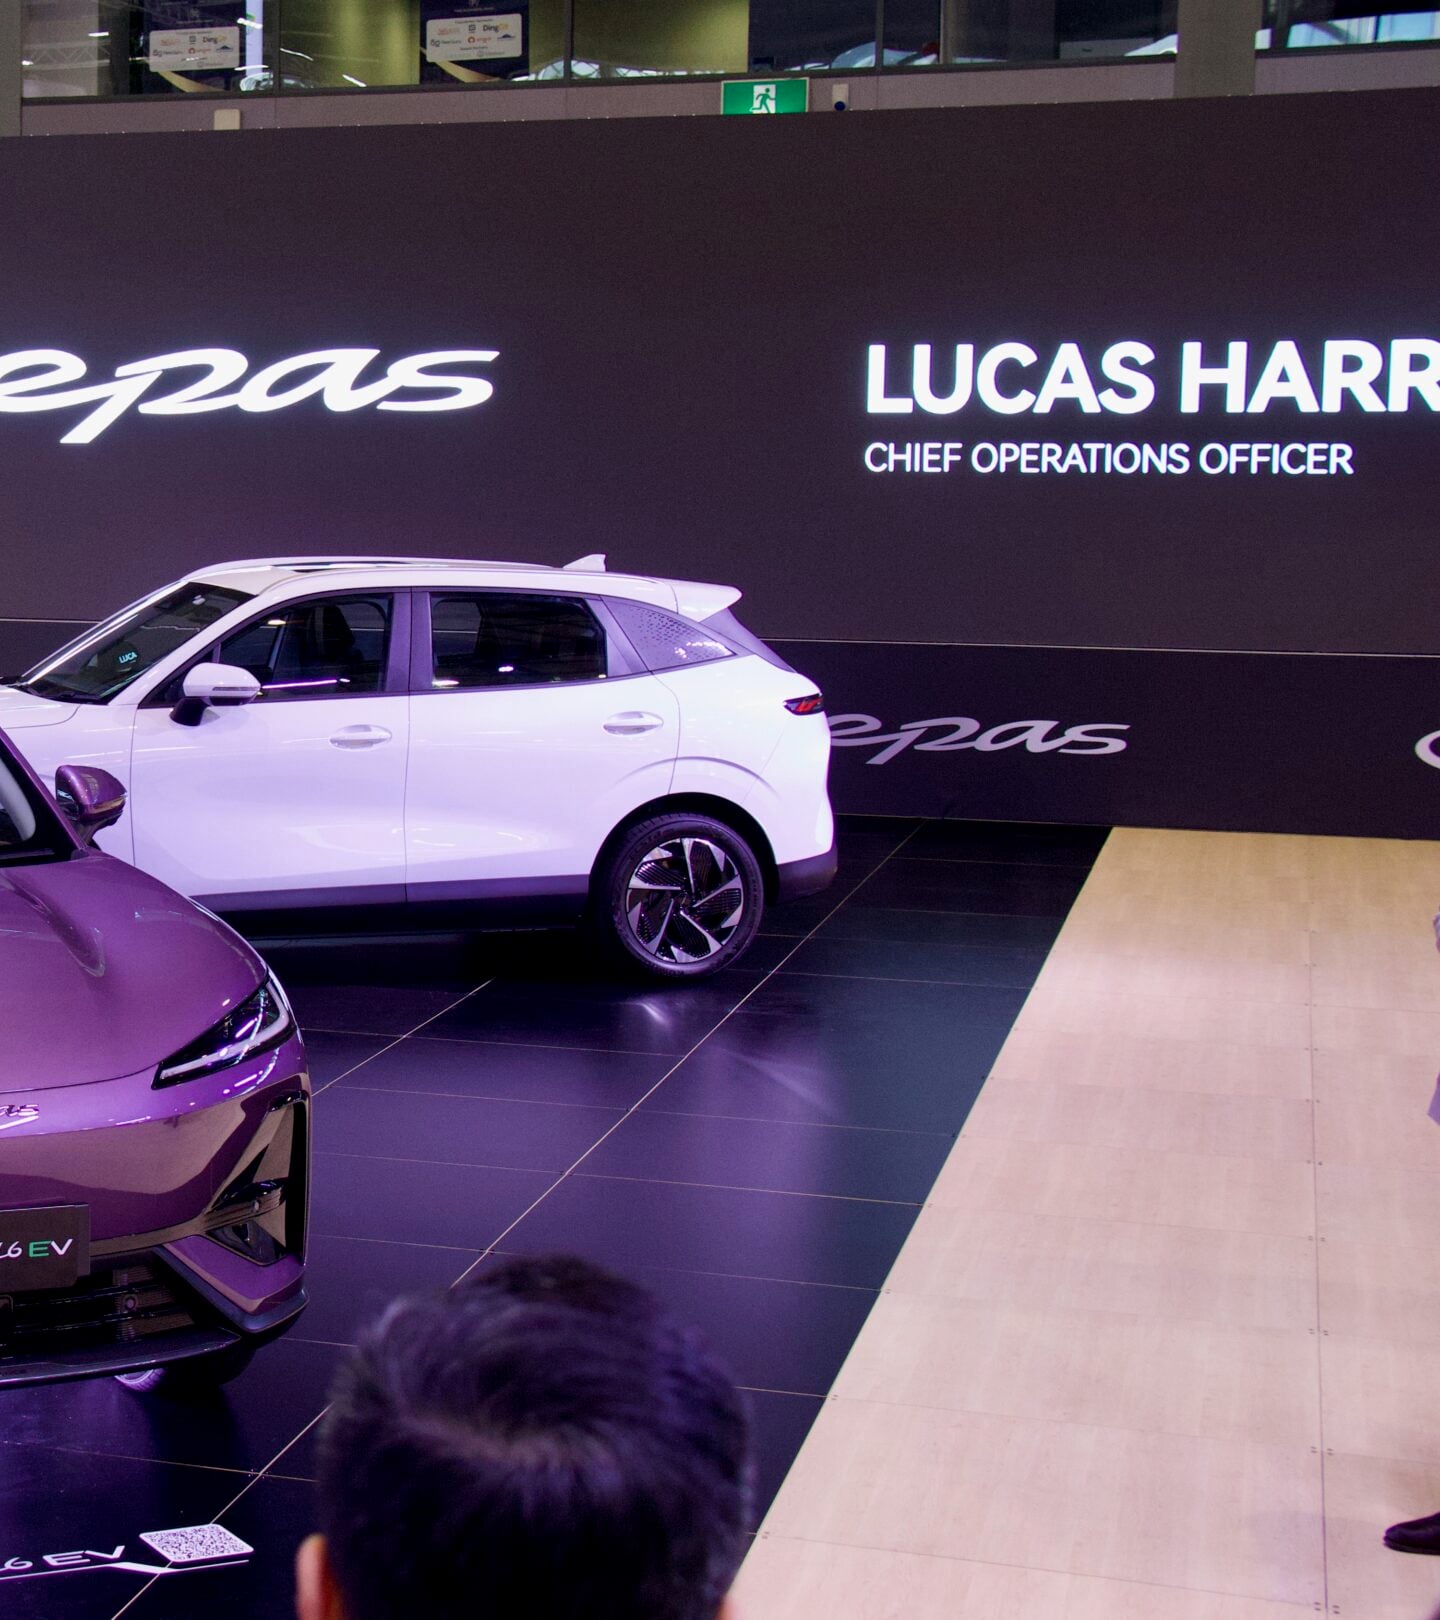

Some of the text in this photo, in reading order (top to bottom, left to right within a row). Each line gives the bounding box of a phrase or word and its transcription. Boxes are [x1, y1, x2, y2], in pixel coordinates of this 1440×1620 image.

[866, 337, 1440, 415] LUCAS HARR
[864, 441, 1355, 475] CHIEF OPERATIONS OFFICER
[829, 713, 1131, 765] epas
[28, 1238, 73, 1258] EV
[43, 1545, 125, 1566] EV
